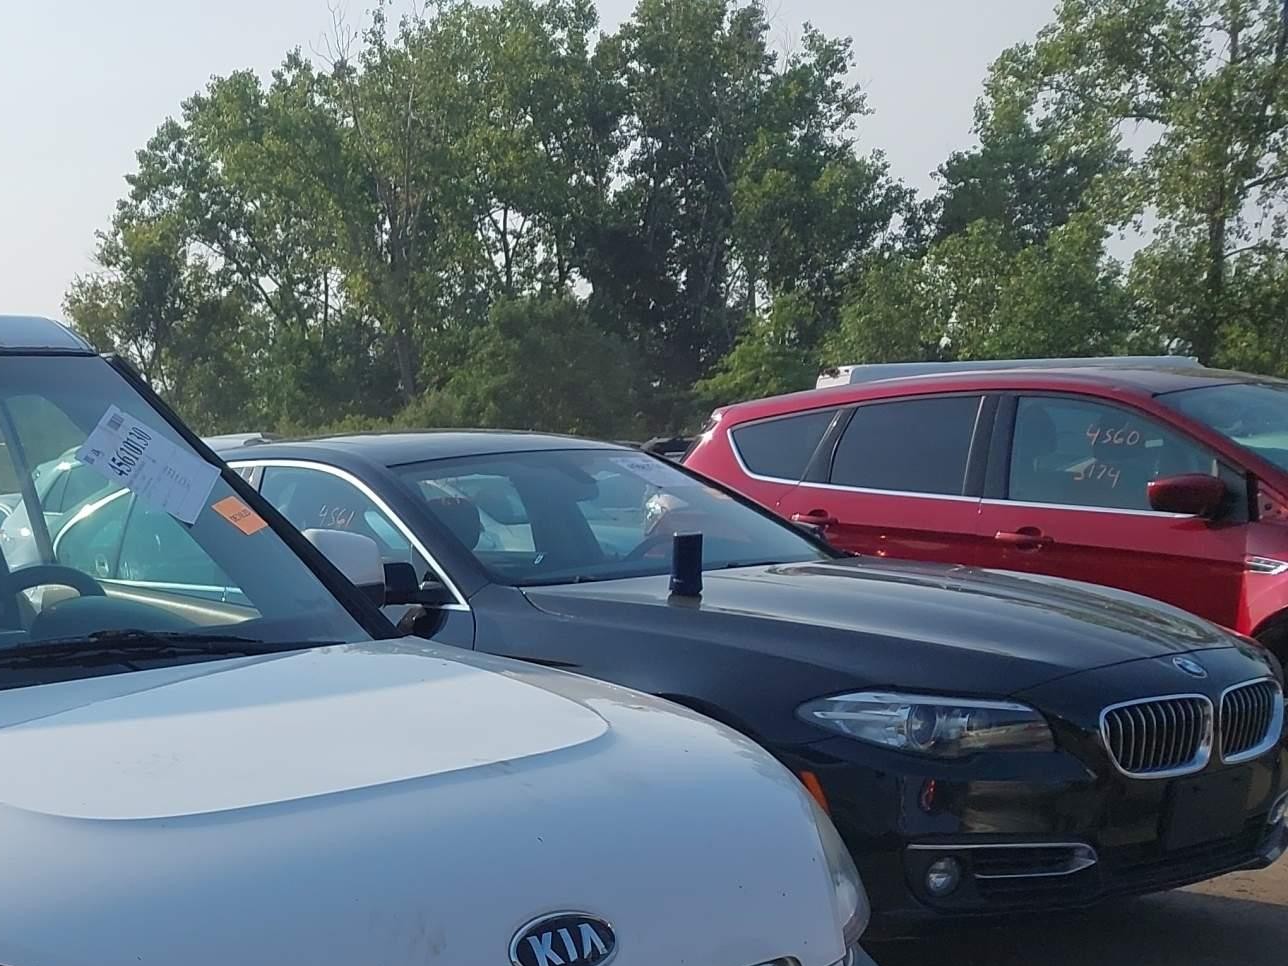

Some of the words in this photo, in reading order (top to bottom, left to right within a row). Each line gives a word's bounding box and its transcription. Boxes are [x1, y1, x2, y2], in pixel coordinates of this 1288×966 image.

[1086, 423, 1140, 446] 4560
[108, 426, 152, 477] 45610130
[319, 504, 355, 527] 4561
